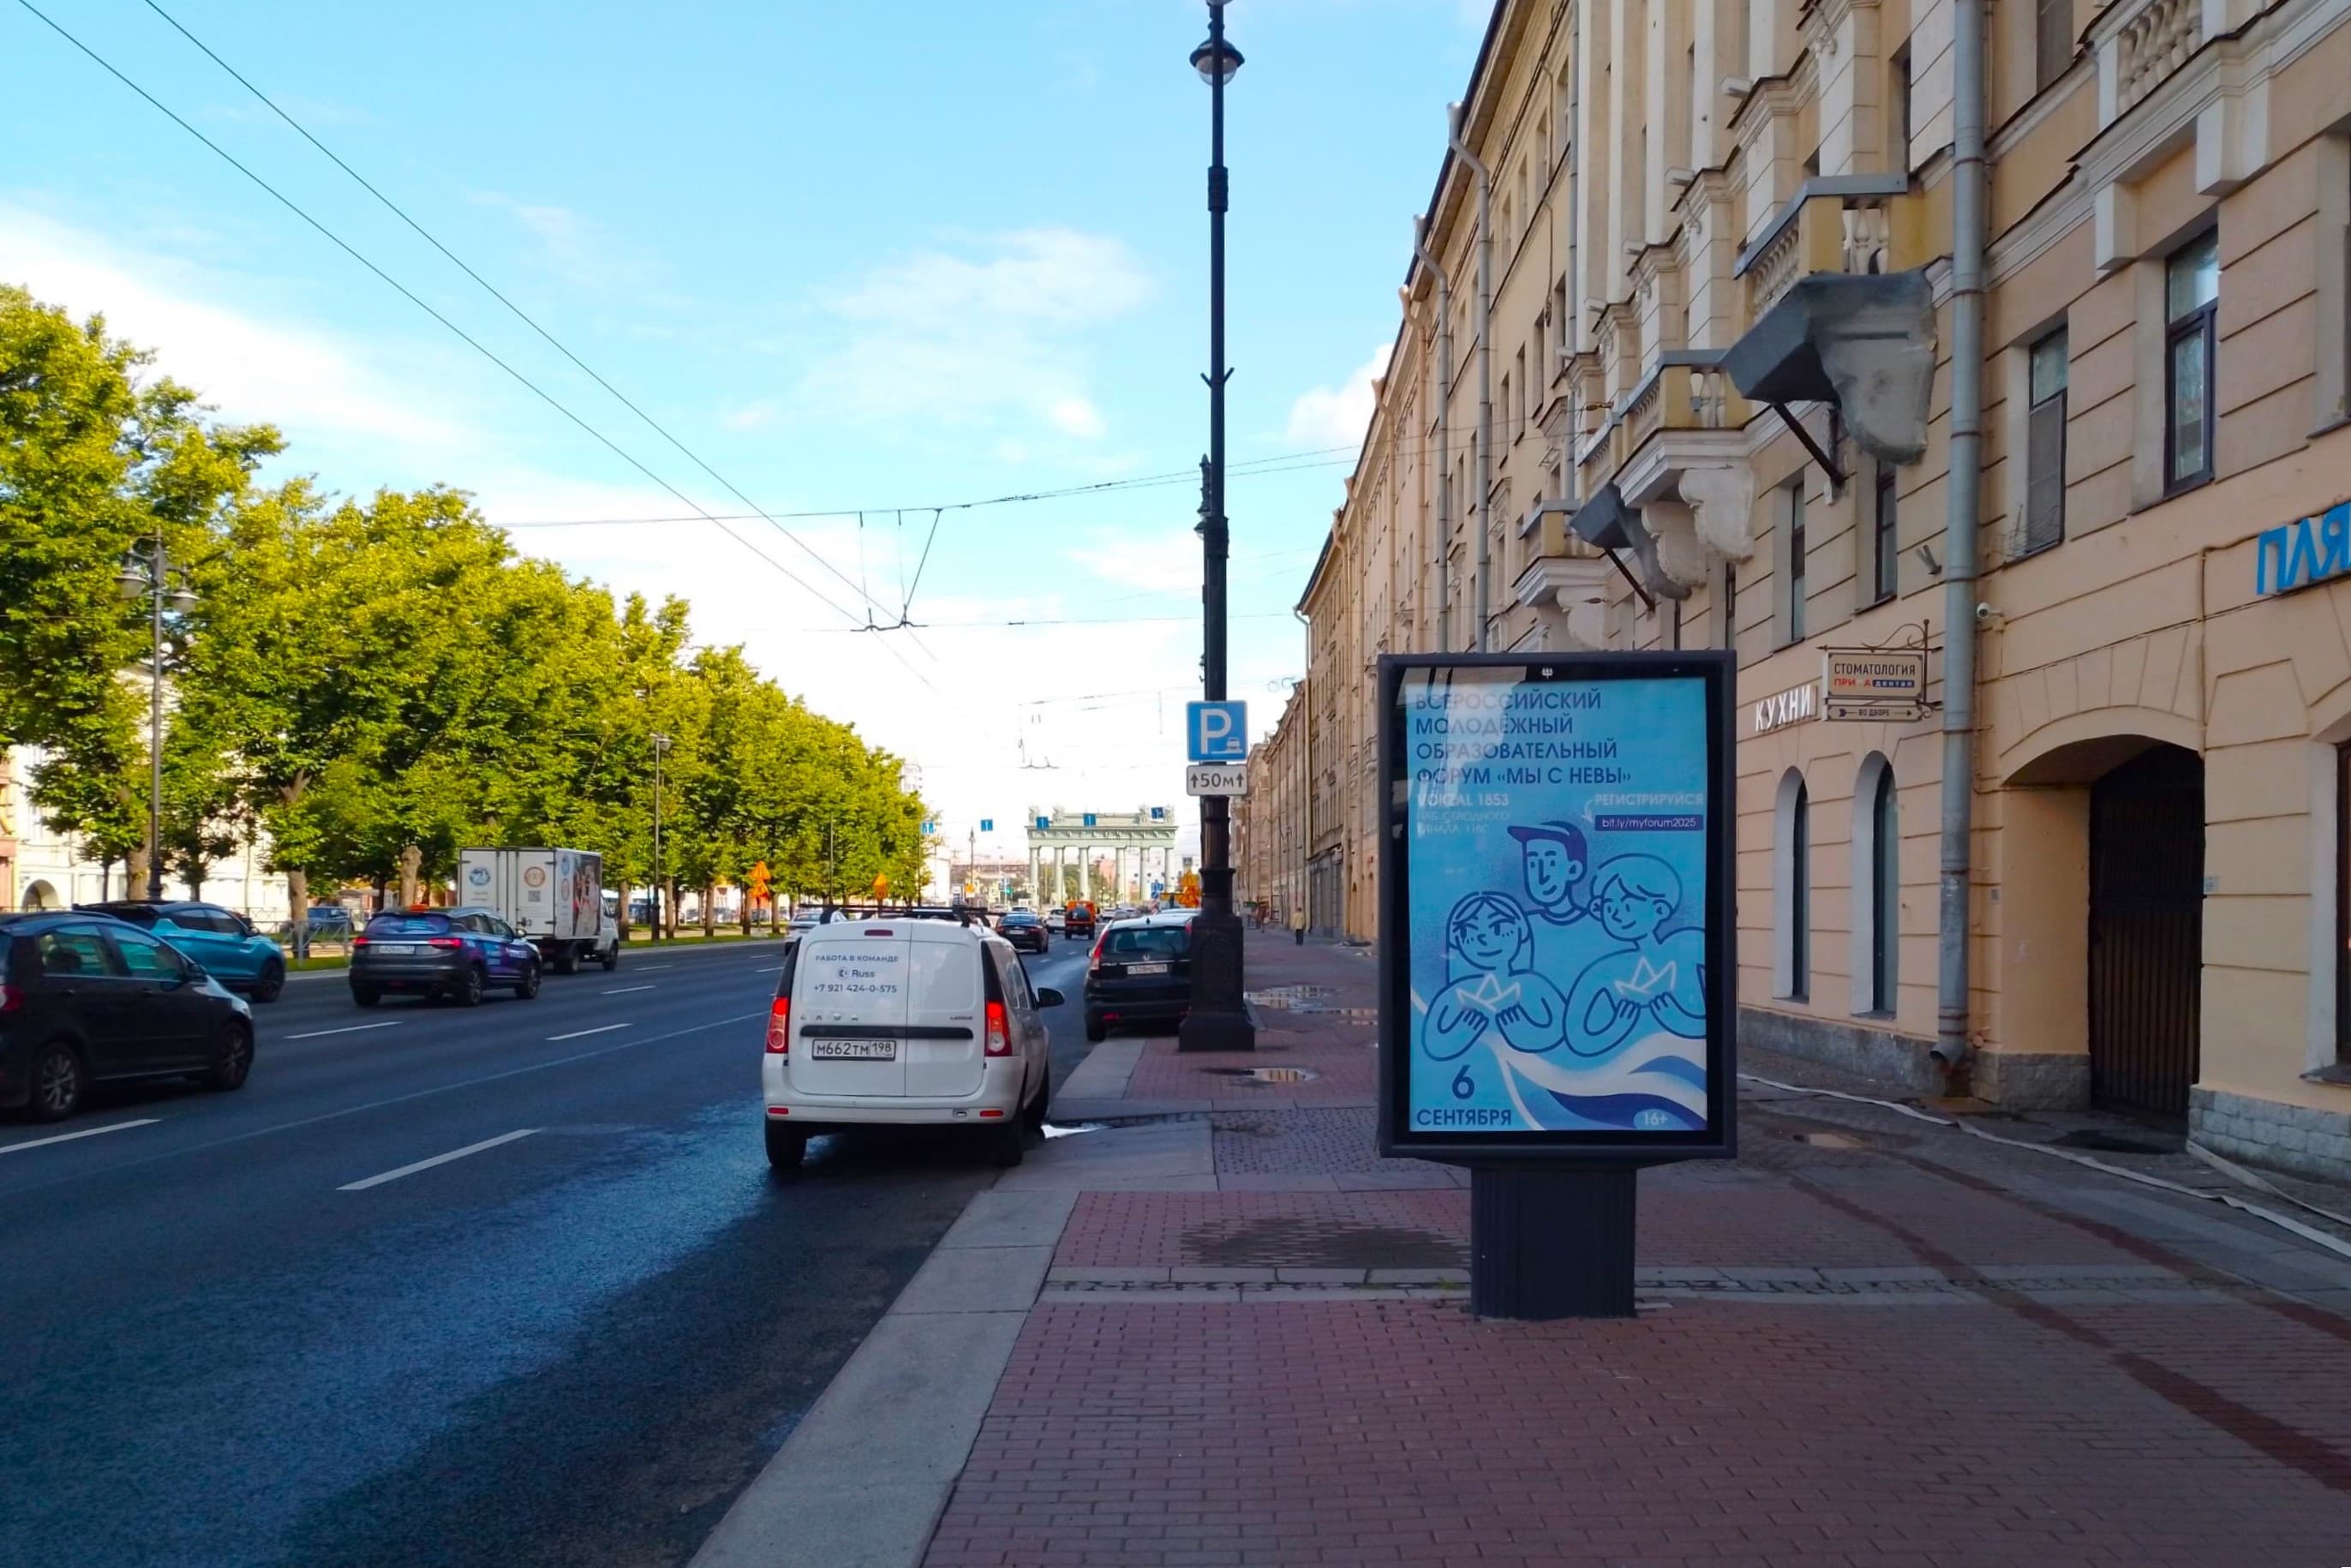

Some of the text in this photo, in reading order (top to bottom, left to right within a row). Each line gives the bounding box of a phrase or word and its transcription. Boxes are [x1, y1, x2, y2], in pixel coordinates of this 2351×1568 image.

[1834, 663, 1916, 675] СТОМАТОЛОГИЯ
[1834, 678, 1871, 686] ПРИА
[1415, 688, 1601, 709] ВСЕРОССИЙСКИЙ
[1756, 685, 1810, 733] КУХНИ
[1869, 709, 1890, 717] ДВОРЕ
[1200, 709, 1232, 754] P
[1415, 712, 1573, 736] МОЛОДЁЖНЫЙ
[1416, 738, 1618, 759] ОБРАЗОВАТЕЛЬНЫЙ
[1417, 767, 1631, 784] ФОРУМ «МЫ С НЕВЫ»
[1479, 793, 1509, 806] 1853
[1594, 791, 1703, 805] РЕГИСТРИРУЙСЯ
[1601, 817, 1696, 829] bit.ly/myforum2025
[852, 969, 876, 978] Russ
[814, 984, 898, 994] +7 921 424-0-575
[1451, 1064, 1475, 1100] 6
[1416, 1109, 1511, 1126] СЕНТЯБРЯ
[1643, 1111, 1668, 1126] 16+
